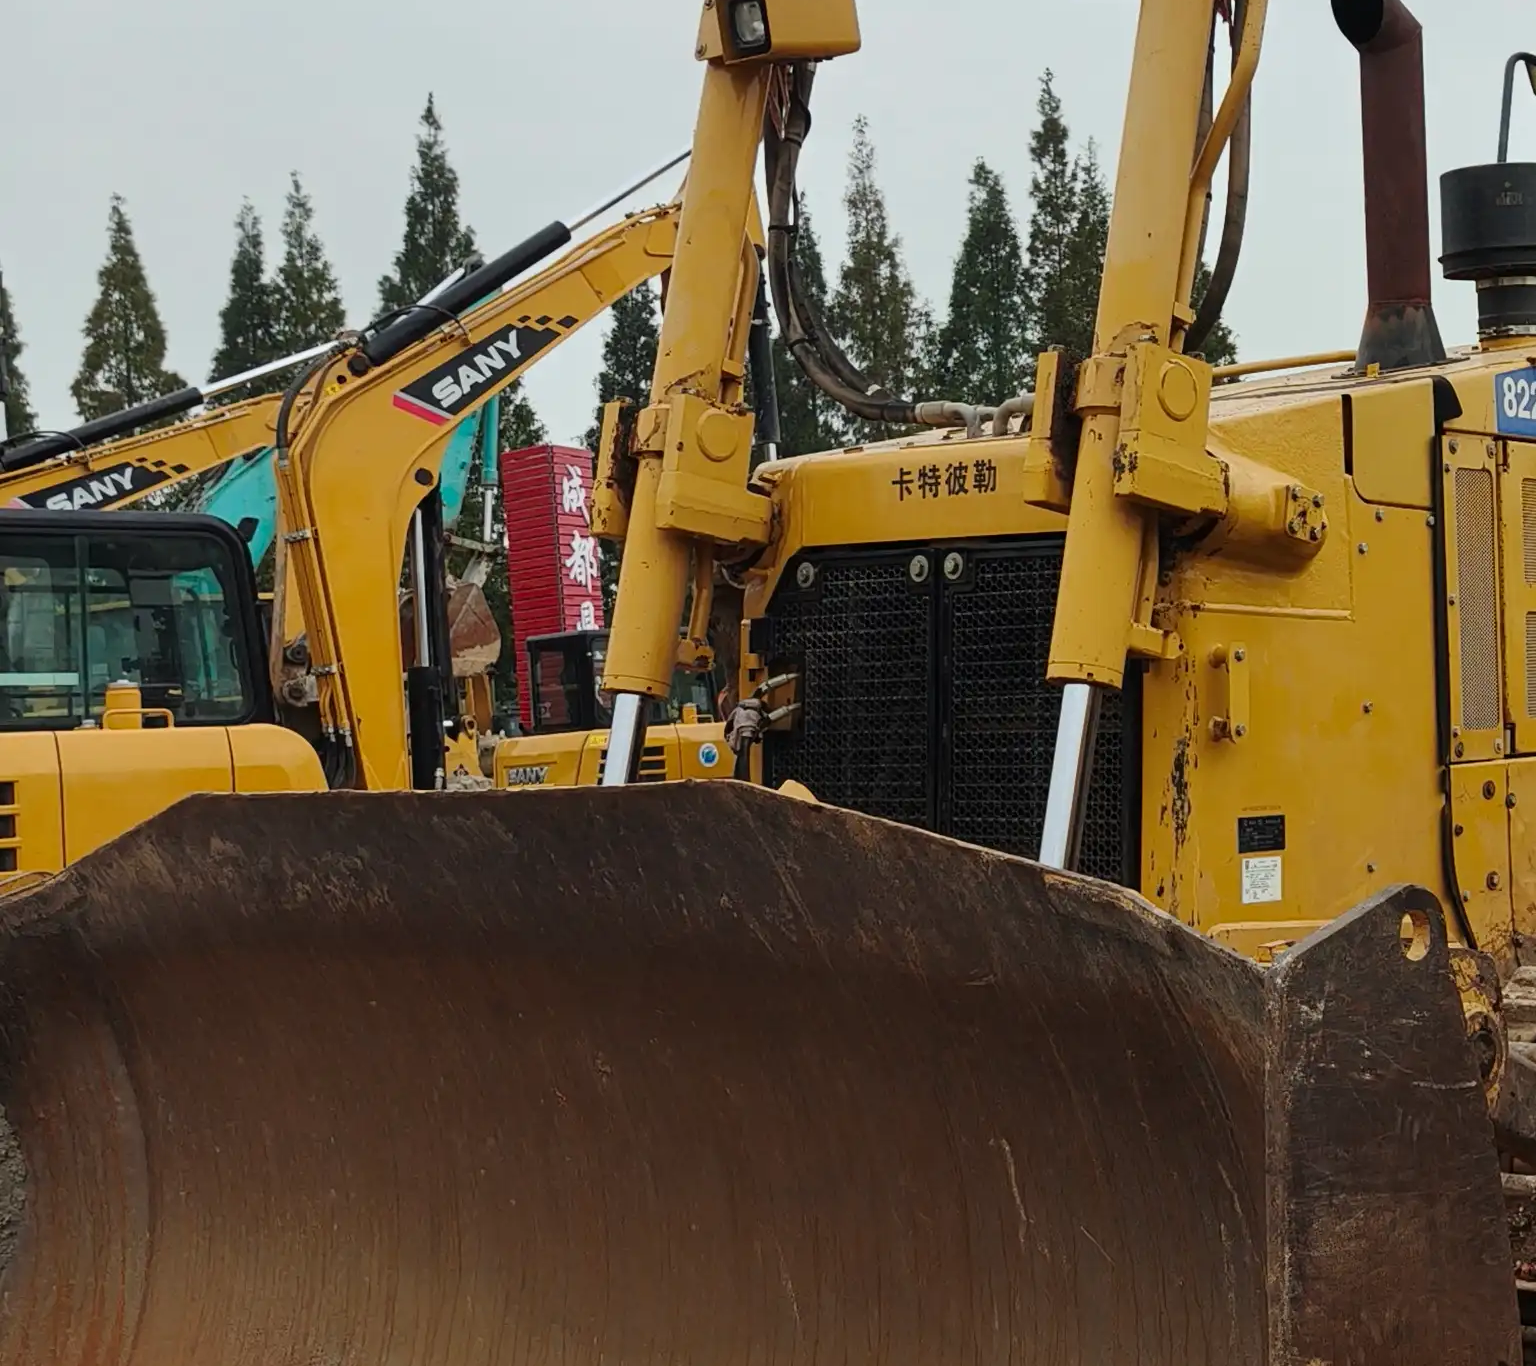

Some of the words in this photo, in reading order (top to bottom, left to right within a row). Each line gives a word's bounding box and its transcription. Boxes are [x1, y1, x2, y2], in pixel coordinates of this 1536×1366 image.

[431, 329, 521, 408] SANY
[46, 467, 133, 510] SANY
[892, 459, 997, 501] 卡特彼勒
[507, 766, 548, 784] SANY
